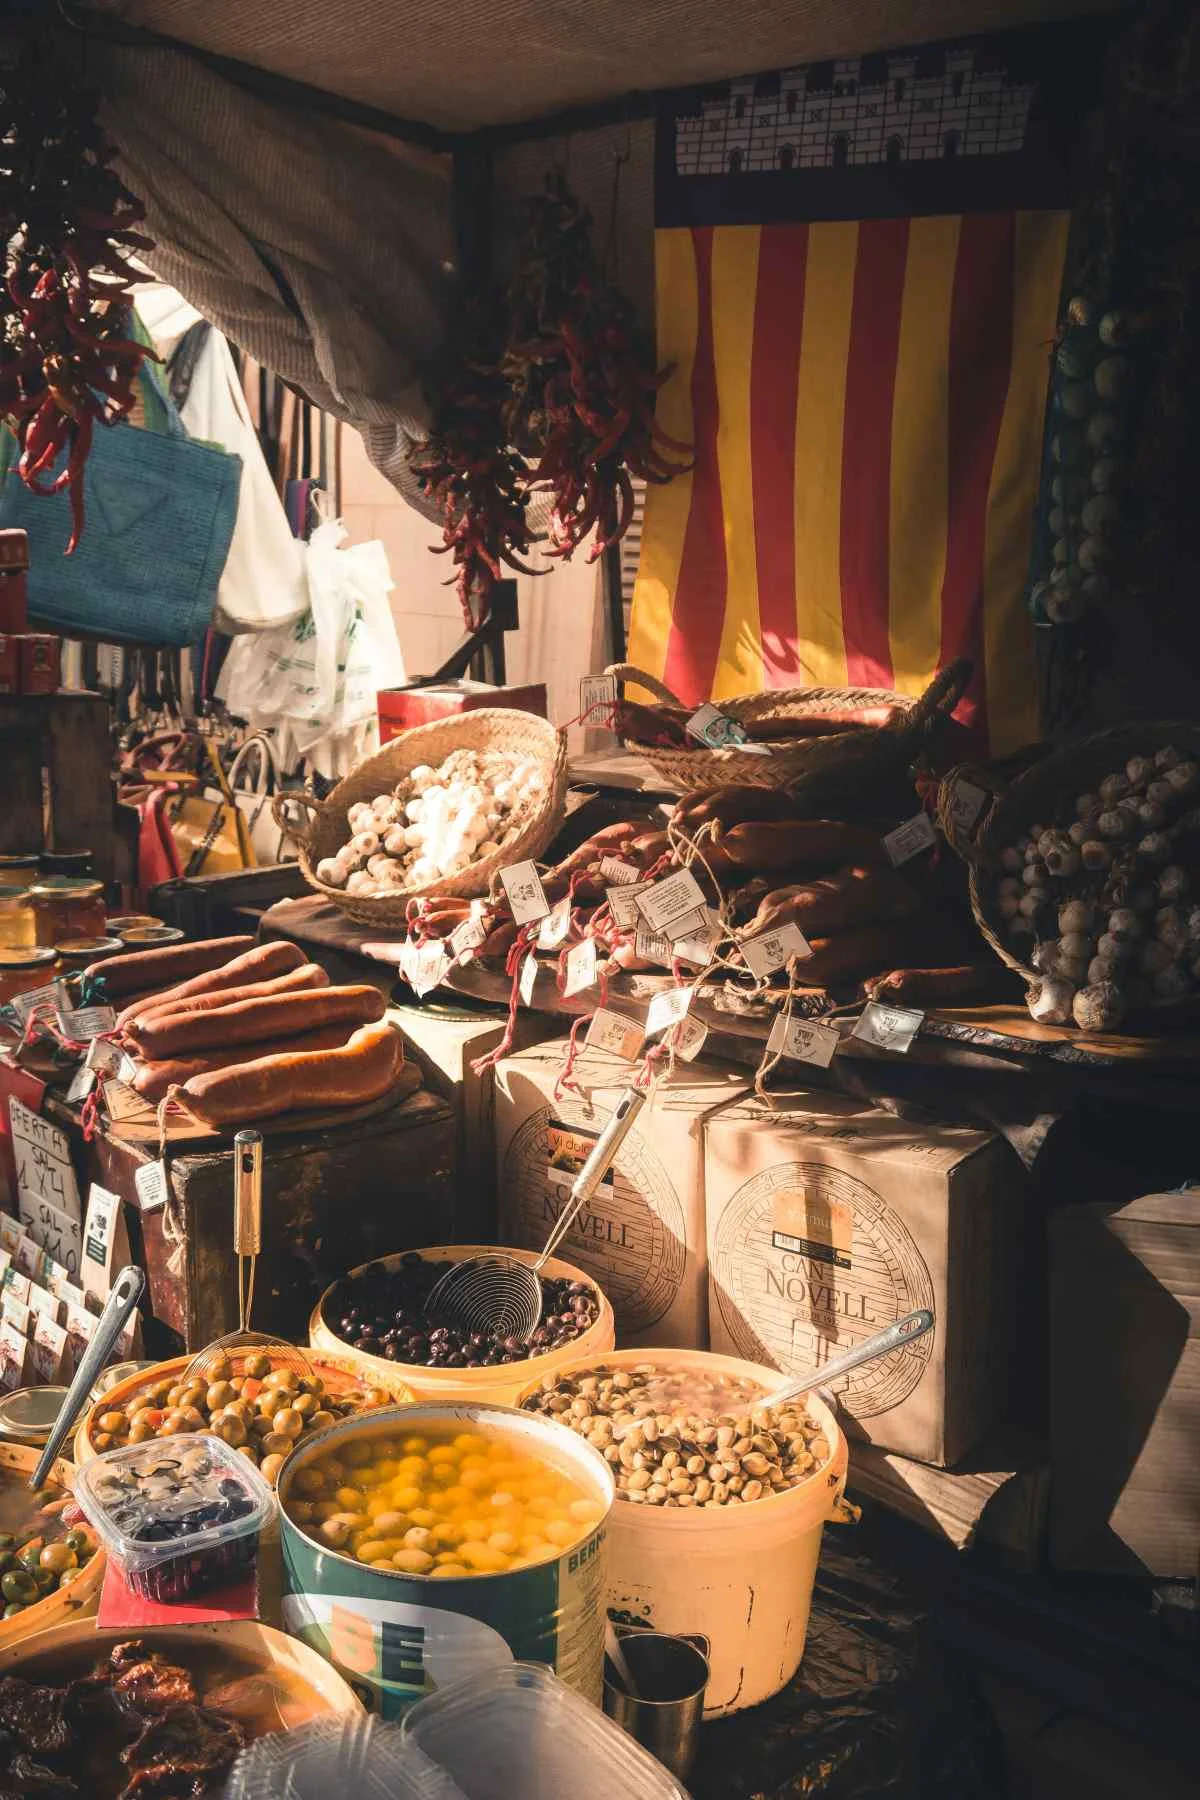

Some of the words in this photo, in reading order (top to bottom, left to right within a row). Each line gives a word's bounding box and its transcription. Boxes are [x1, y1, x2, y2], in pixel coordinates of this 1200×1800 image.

[542, 1195, 634, 1250] NOVELL
[764, 1265, 876, 1323] NOVELL
[781, 1253, 824, 1283] CAN
